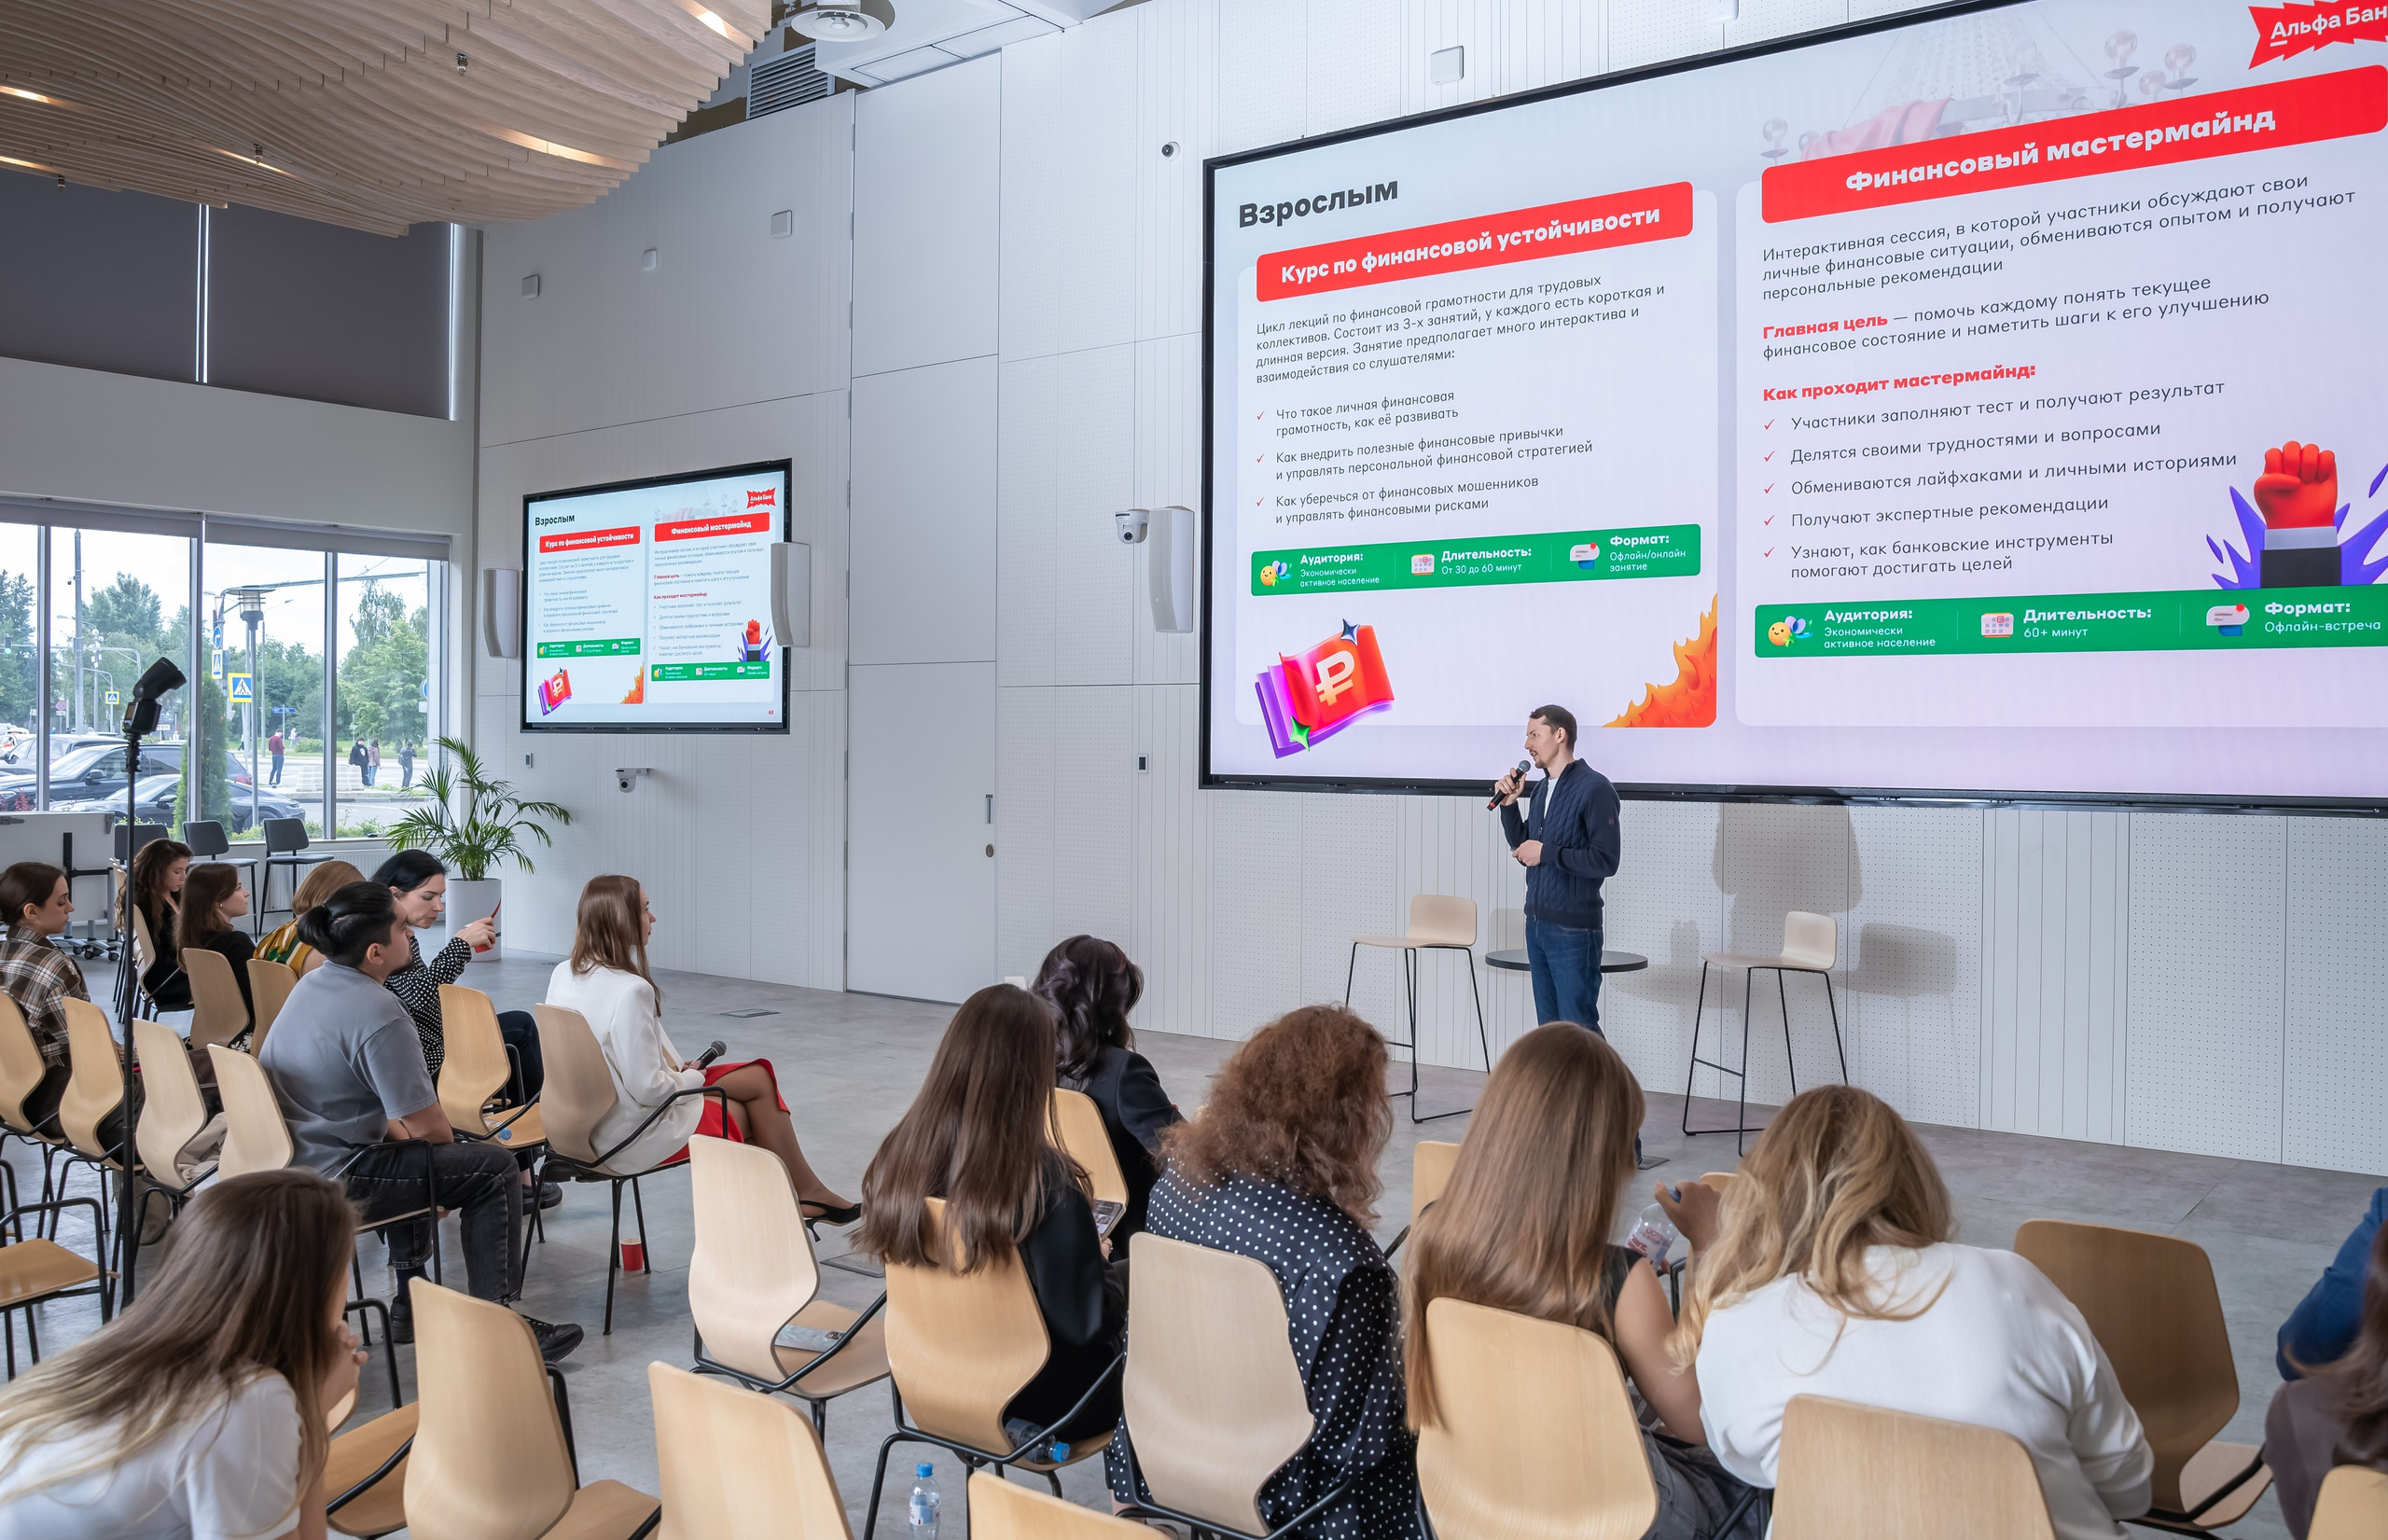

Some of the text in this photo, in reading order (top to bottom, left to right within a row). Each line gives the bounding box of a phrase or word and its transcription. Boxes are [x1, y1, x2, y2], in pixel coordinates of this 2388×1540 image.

[2270, 6, 2388, 40] Альфа Бан
[1846, 110, 2276, 191] Финансовый мастермайнд
[1239, 180, 1397, 229] Взрослым
[1764, 176, 2307, 261] Интерактивная сессия, в которой участники обсуждают свои
[1282, 209, 1659, 284] Курс по финансовой устойчивости
[1763, 192, 2355, 281] личные финансовые ситуации, обмениваются опытом и получают
[1763, 261, 2003, 301] персональные рекомендации
[1256, 333, 1330, 350] коллективов.
[1334, 325, 1381, 340] Состоит
[1386, 323, 1399, 332] из
[1427, 308, 1481, 326] занятий,
[1496, 301, 1550, 317] каждого
[1555, 298, 1584, 309] есть
[1589, 287, 1651, 305] короткая
[1257, 276, 1601, 335] Цикл лекций по финансовой грамотности для трудовых
[1763, 278, 2211, 339] Главная цель помочь каждому понять текущее
[1256, 310, 1626, 368] длинная версия. Занятие предполагает много интерактива
[1763, 293, 2269, 361] финансовое состояние и наметить шаги к его улучшению
[1256, 350, 1454, 383] взаимодействия со слушателями:
[1763, 364, 2035, 401] Как проходит мастермайнд:
[1276, 392, 1454, 420] Что такое личная финансовая
[1791, 383, 2225, 430] Участники заполняют тест и получают результат
[1276, 409, 1459, 438] грамотность, как её развивать
[1276, 427, 1563, 464] Как внедрить полезные финансовые привычки
[1790, 424, 2160, 465] Делятся своими трудностями и вопросами
[1286, 440, 1592, 481] управлять персональной финансовой стратегией
[1792, 455, 2236, 494] Обмениваются лайфхаками и личными историями
[1276, 478, 1538, 507] Как уберечься от финансовых мошенников
[535, 515, 575, 527] Взрослым
[1285, 500, 1489, 525] управлять финансовыми рисками
[1792, 499, 2108, 528] Получают экспертные рекомендации
[1441, 548, 1532, 563] Длительность:
[1610, 535, 1669, 548] Формат:
[1610, 548, 1686, 562] Офлайн/онлайн
[1791, 534, 2113, 560] Узнают, как банковские инструменты
[1300, 553, 1363, 566] Аудитория:
[1300, 568, 1356, 577] Экономически
[1441, 563, 1522, 575] От 30 до 60 минут
[1610, 563, 1647, 572] занятие
[1791, 555, 2012, 578] помогают достигать целей
[1338, 576, 1380, 586] население
[1824, 610, 1912, 624] Аудитория:
[2023, 608, 2151, 624] Длительность:
[2265, 602, 2351, 617] Формат:
[1825, 627, 1903, 637] Экономически
[2024, 627, 2089, 639] 60+ минут
[2265, 620, 2381, 634] Офлайн-встреча
[1824, 639, 1936, 648] активное население
